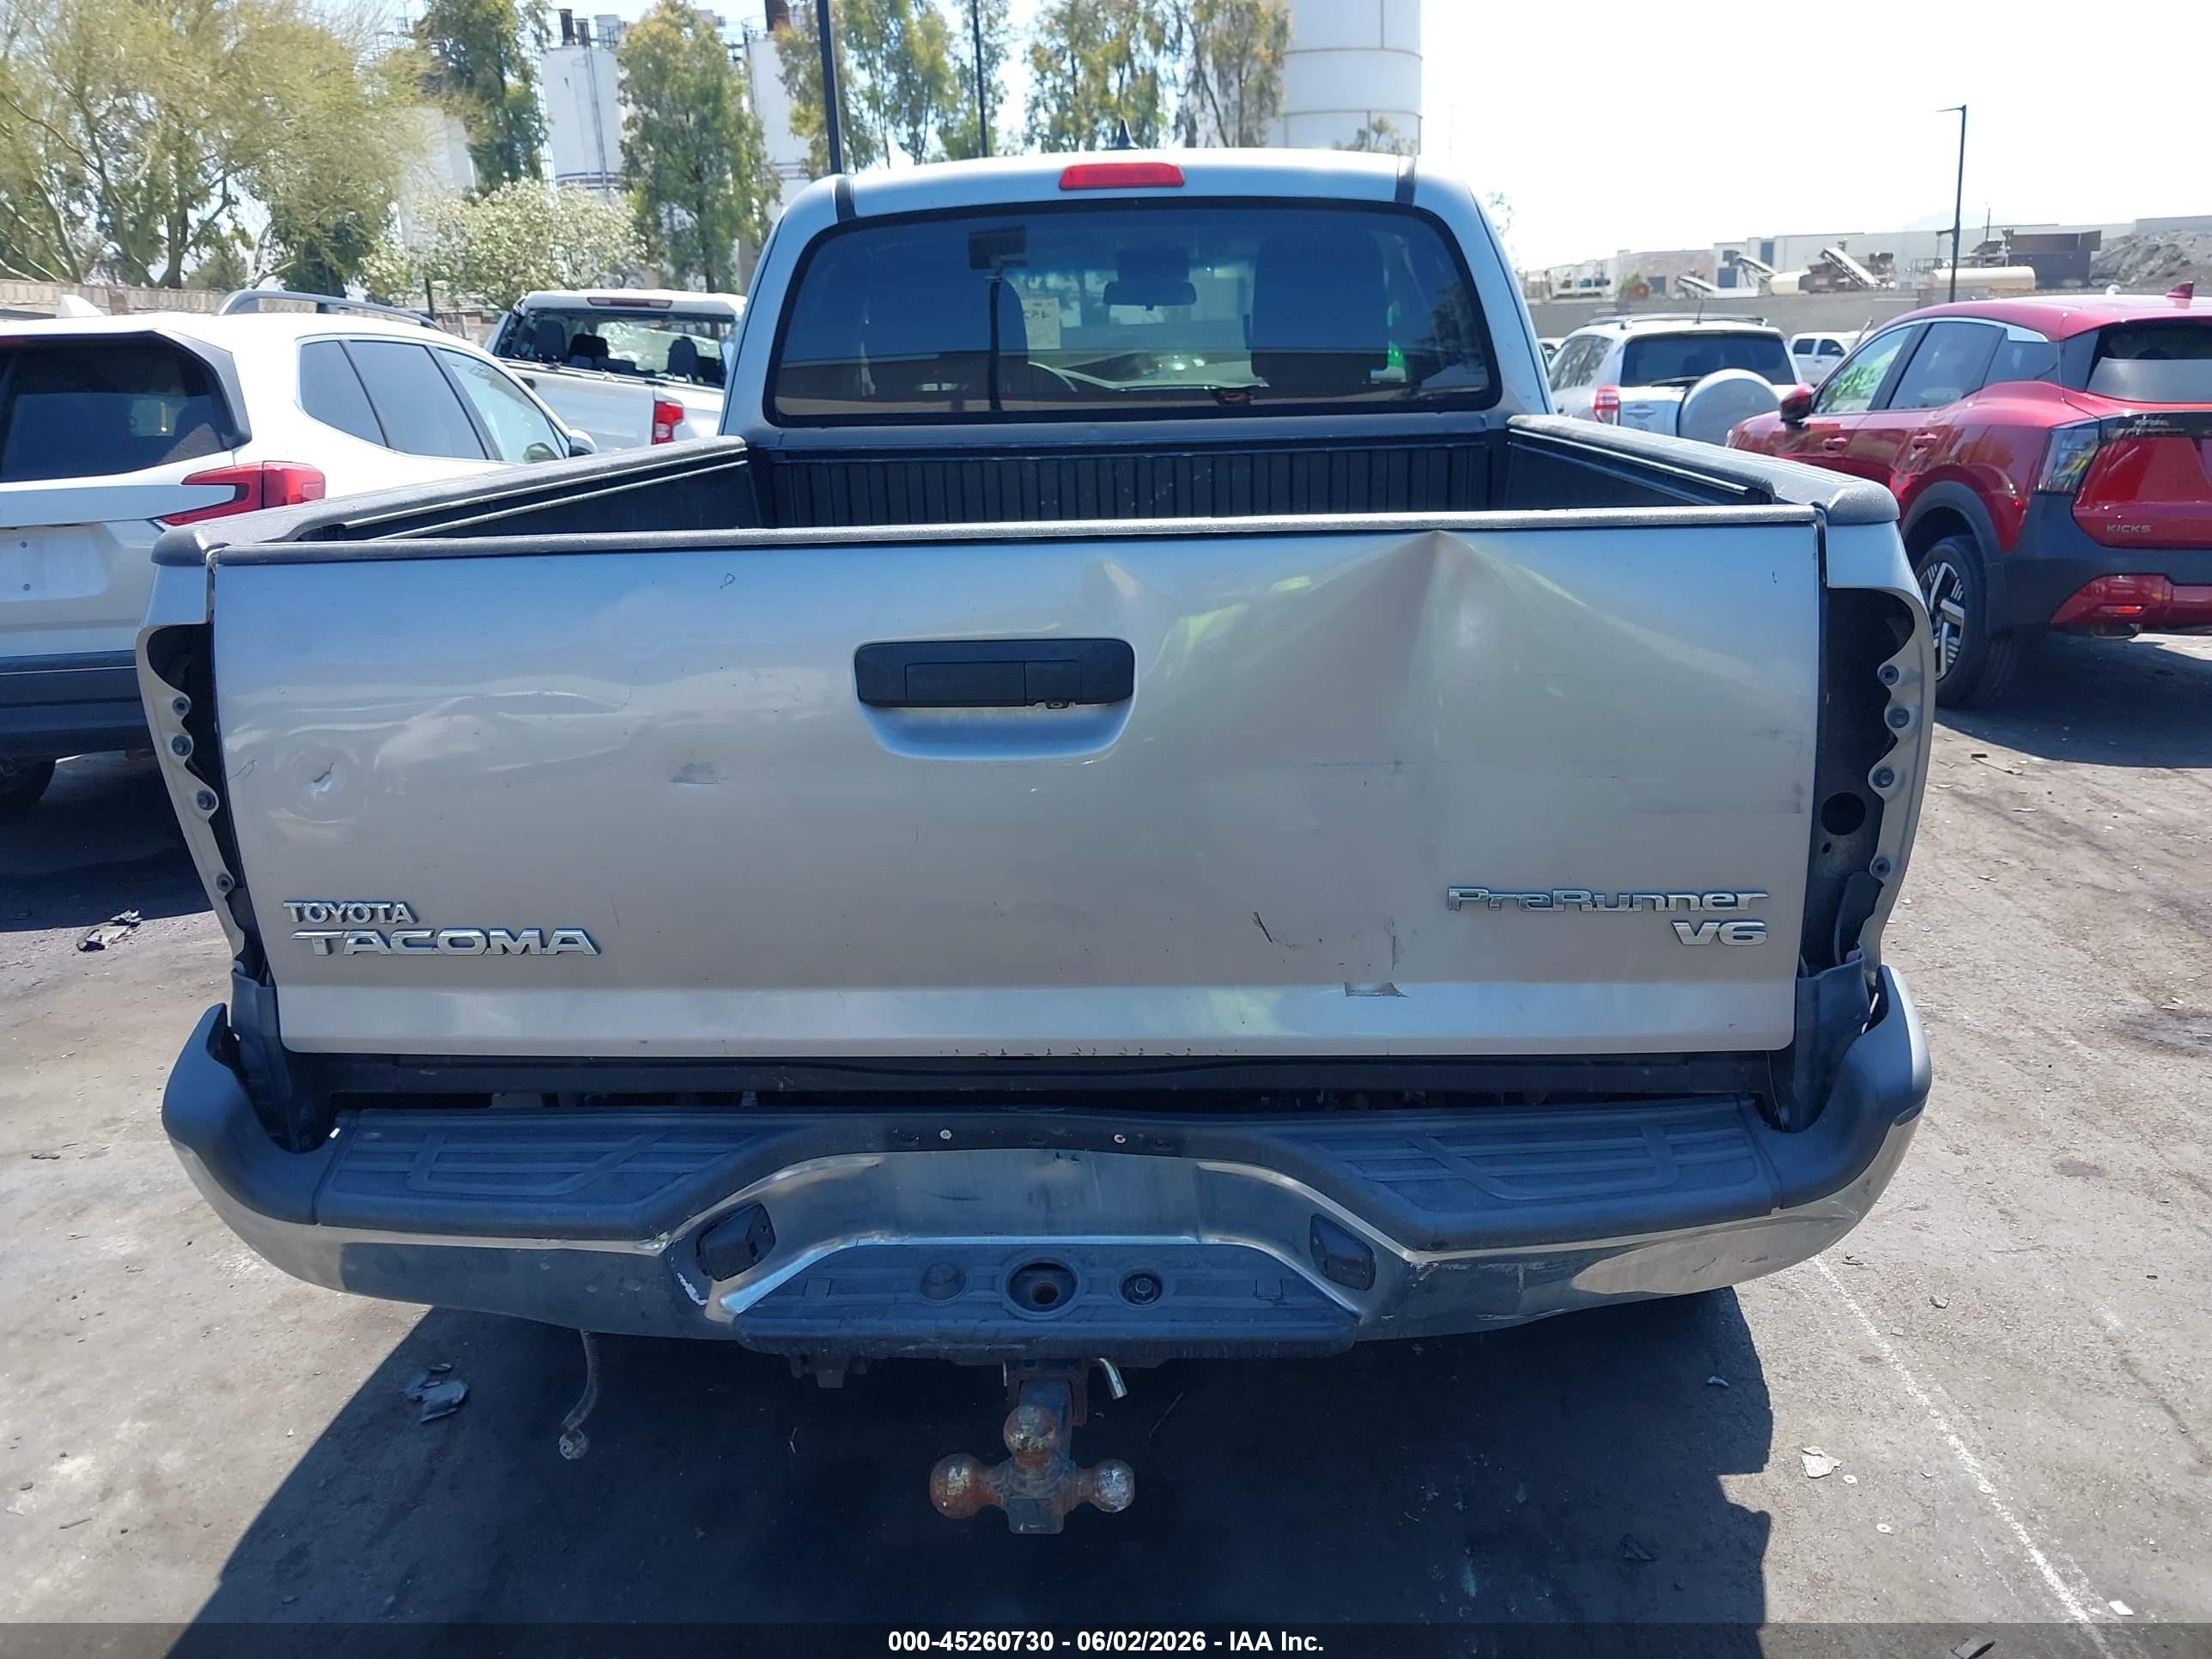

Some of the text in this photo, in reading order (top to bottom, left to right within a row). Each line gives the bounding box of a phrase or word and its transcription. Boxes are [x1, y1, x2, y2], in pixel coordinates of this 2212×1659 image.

[2106, 524, 2151, 533] KICKS
[1448, 887, 1770, 912] PreRunner
[283, 900, 418, 924] TOYOTA
[290, 928, 601, 956] TACOMA
[1671, 921, 1769, 945] V6
